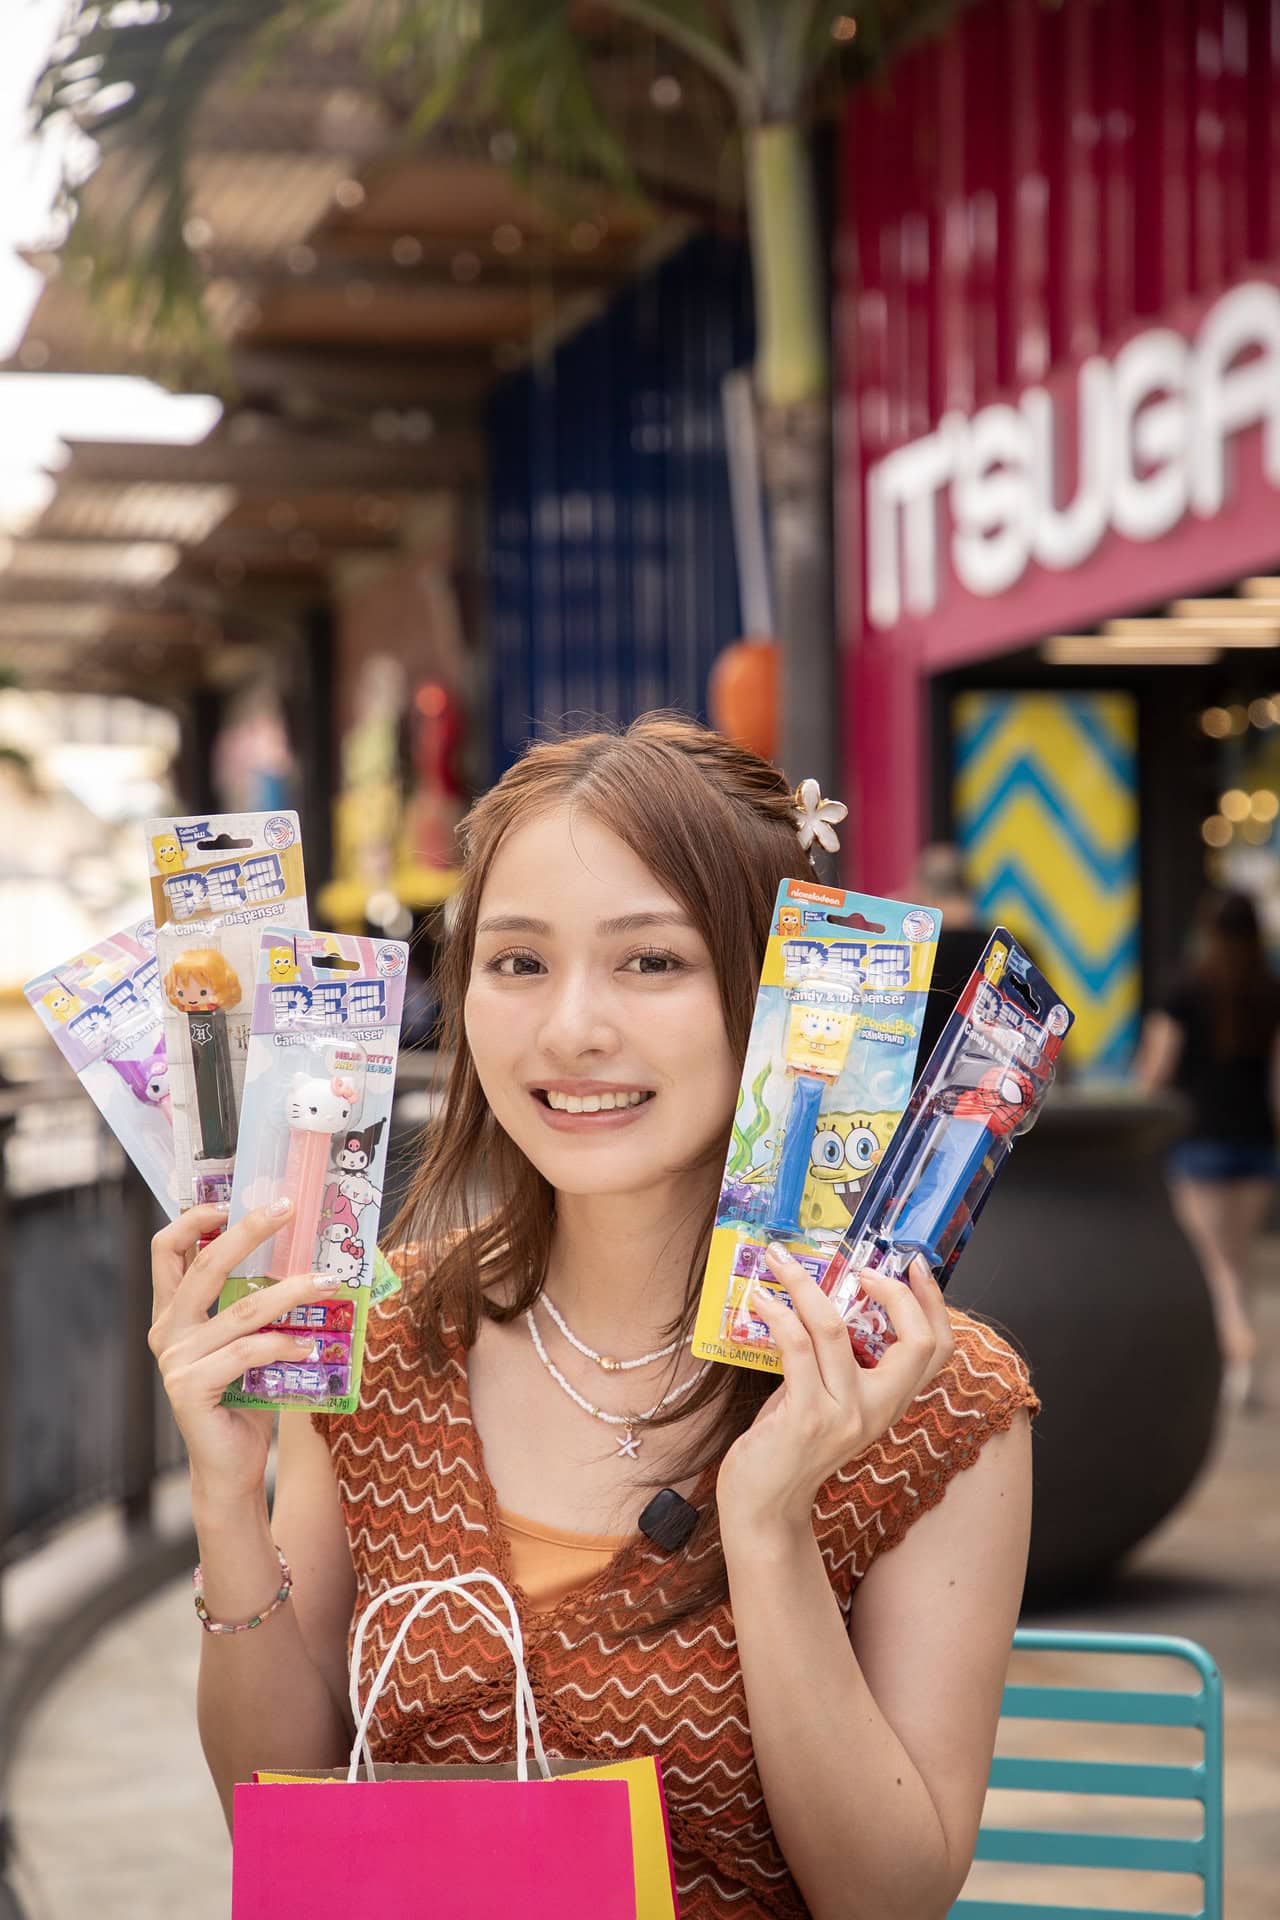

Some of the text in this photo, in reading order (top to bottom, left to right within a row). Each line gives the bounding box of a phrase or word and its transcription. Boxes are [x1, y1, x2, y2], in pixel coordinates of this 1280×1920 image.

[162, 853, 286, 920] PEZ
[790, 889, 841, 906] nickelodeon
[223, 904, 285, 926] Dispenser
[782, 940, 912, 988] PEZ
[270, 980, 386, 1030] PEZ
[973, 980, 1049, 1069] PEZ
[354, 1063, 393, 1075] IENDS
[701, 1342, 780, 1368] TOTAL CANDY NET
